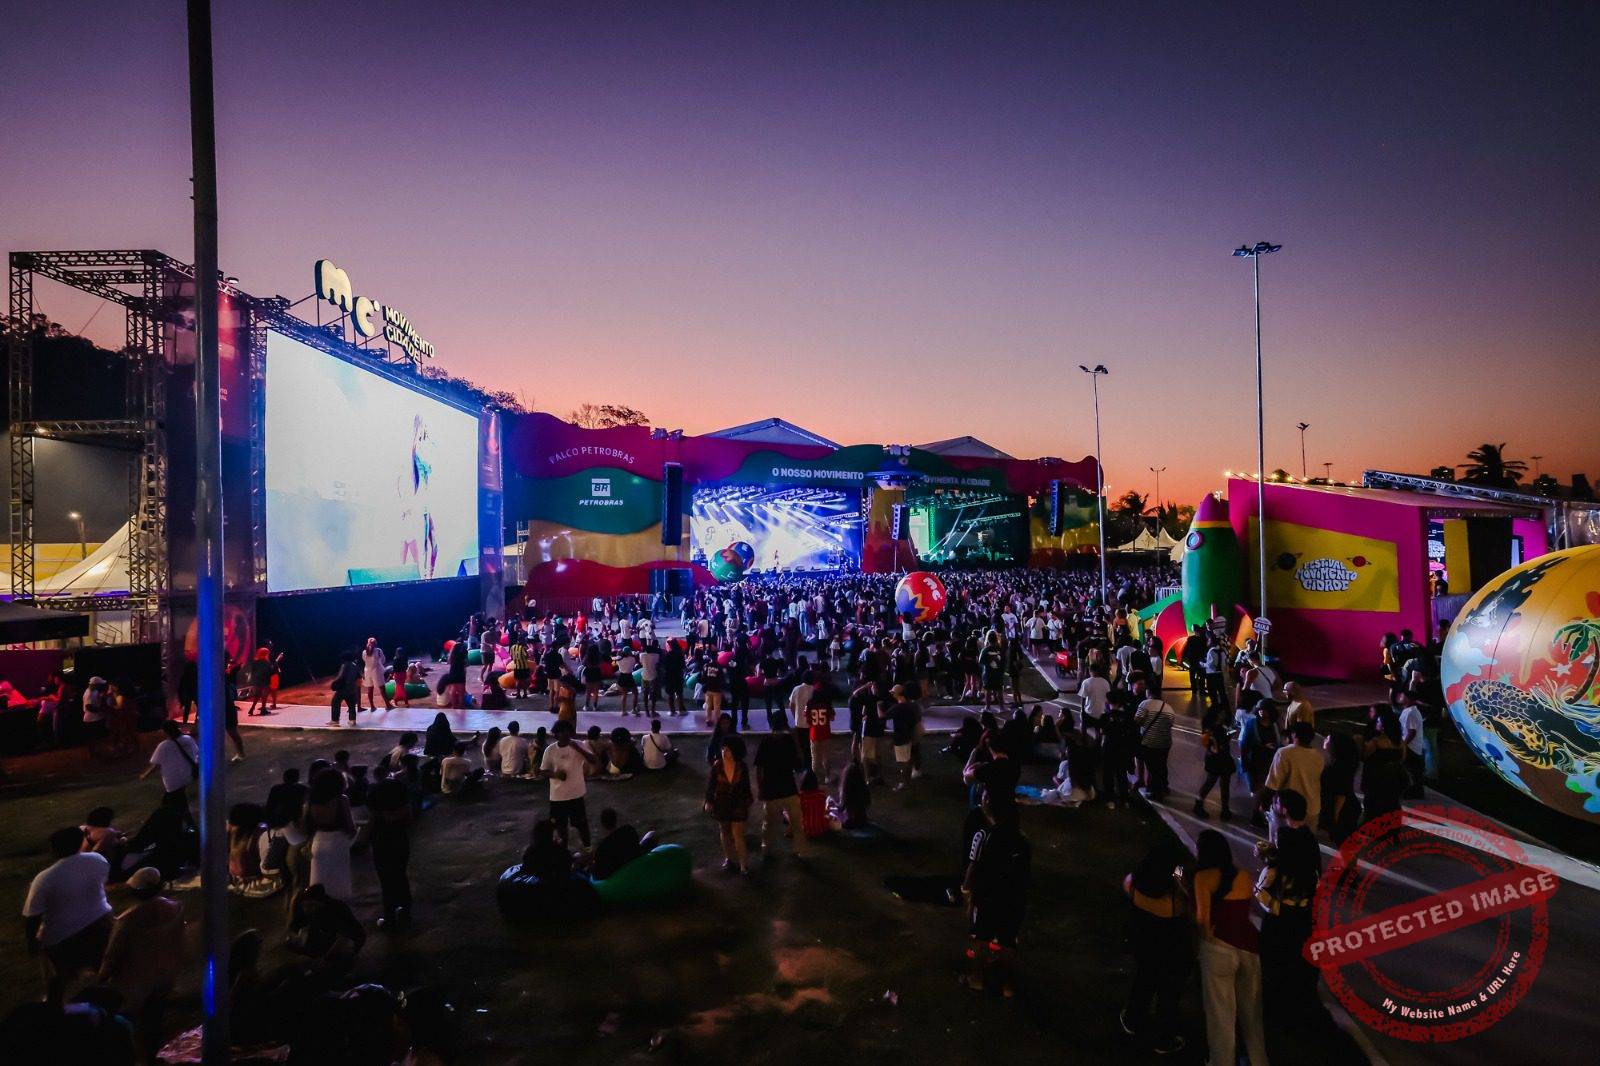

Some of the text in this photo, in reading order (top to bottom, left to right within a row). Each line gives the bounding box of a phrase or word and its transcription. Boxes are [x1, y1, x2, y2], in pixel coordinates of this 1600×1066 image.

[384, 305, 435, 358] MOVIMENTO
[384, 326, 420, 362] CIDADE
[581, 446, 635, 464] PETROBRAS
[772, 467, 864, 480] O NOSSO MOVIMENTO
[1304, 558, 1347, 570] FESTIVAL
[1295, 568, 1358, 581] MOVIMENTO
[1302, 580, 1350, 592] CIDADE
[811, 709, 827, 726] 95
